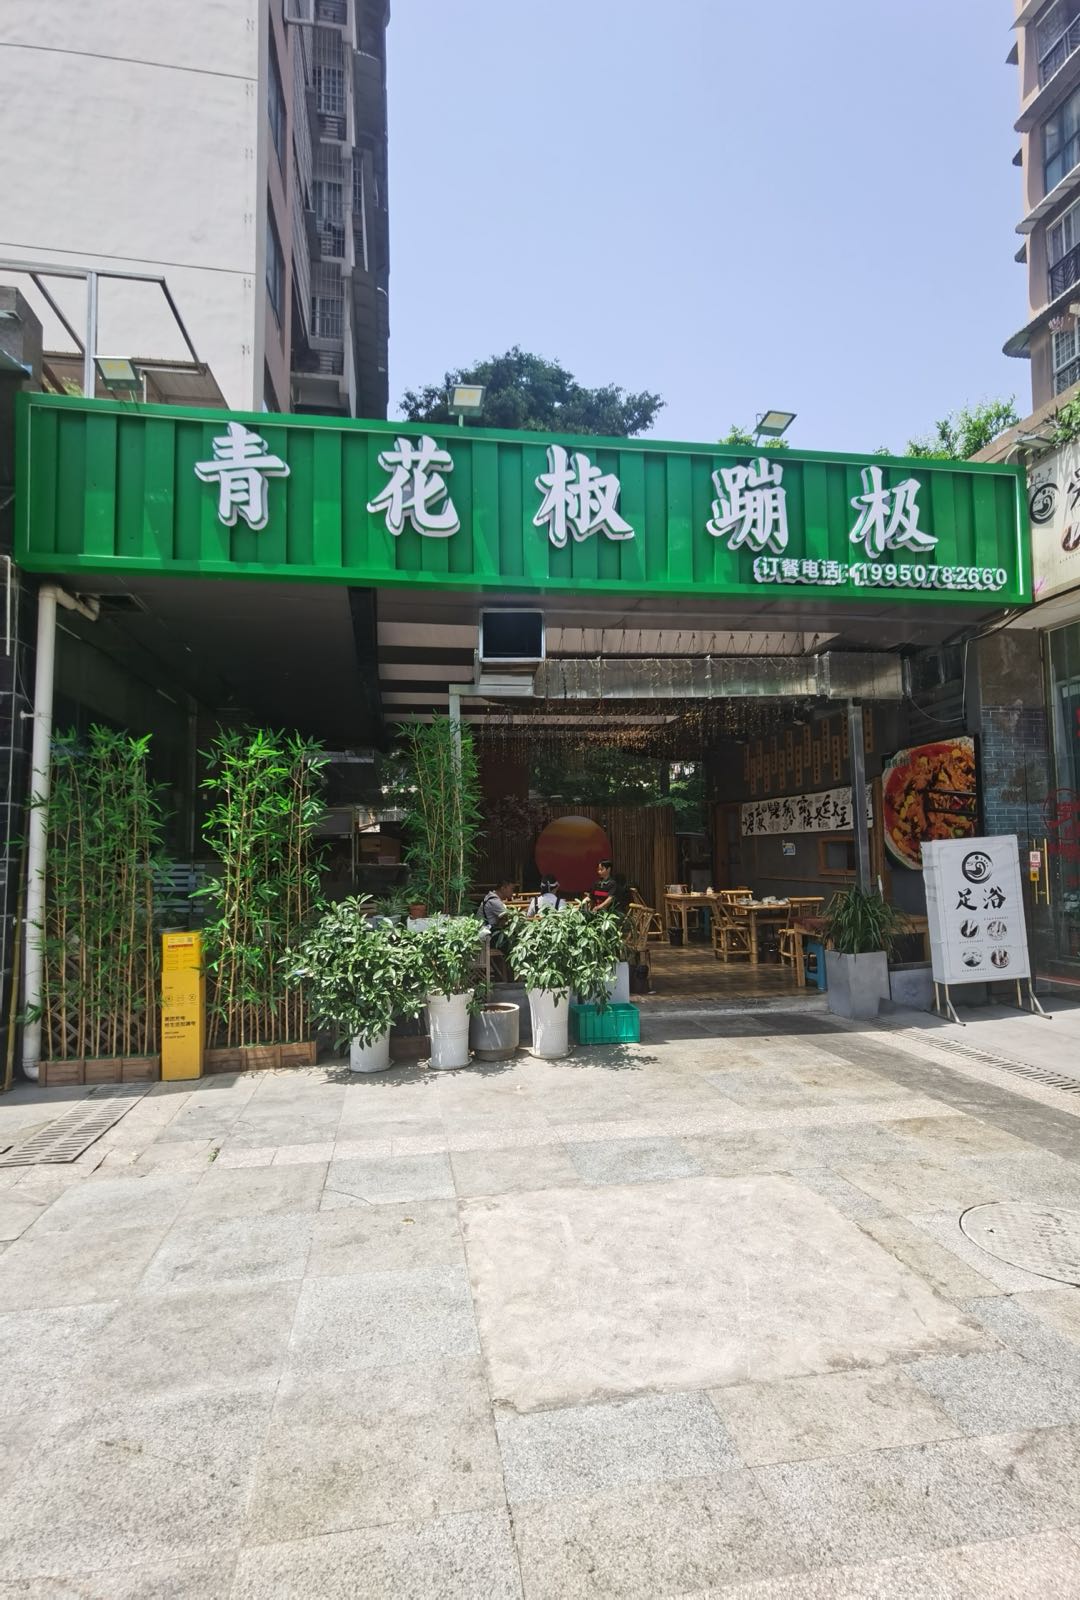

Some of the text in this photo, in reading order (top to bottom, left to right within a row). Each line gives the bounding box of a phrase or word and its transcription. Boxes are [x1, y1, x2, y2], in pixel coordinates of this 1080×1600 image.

[194, 421, 939, 559] 青花椒蹦极
[956, 886, 1006, 911] 足浴
